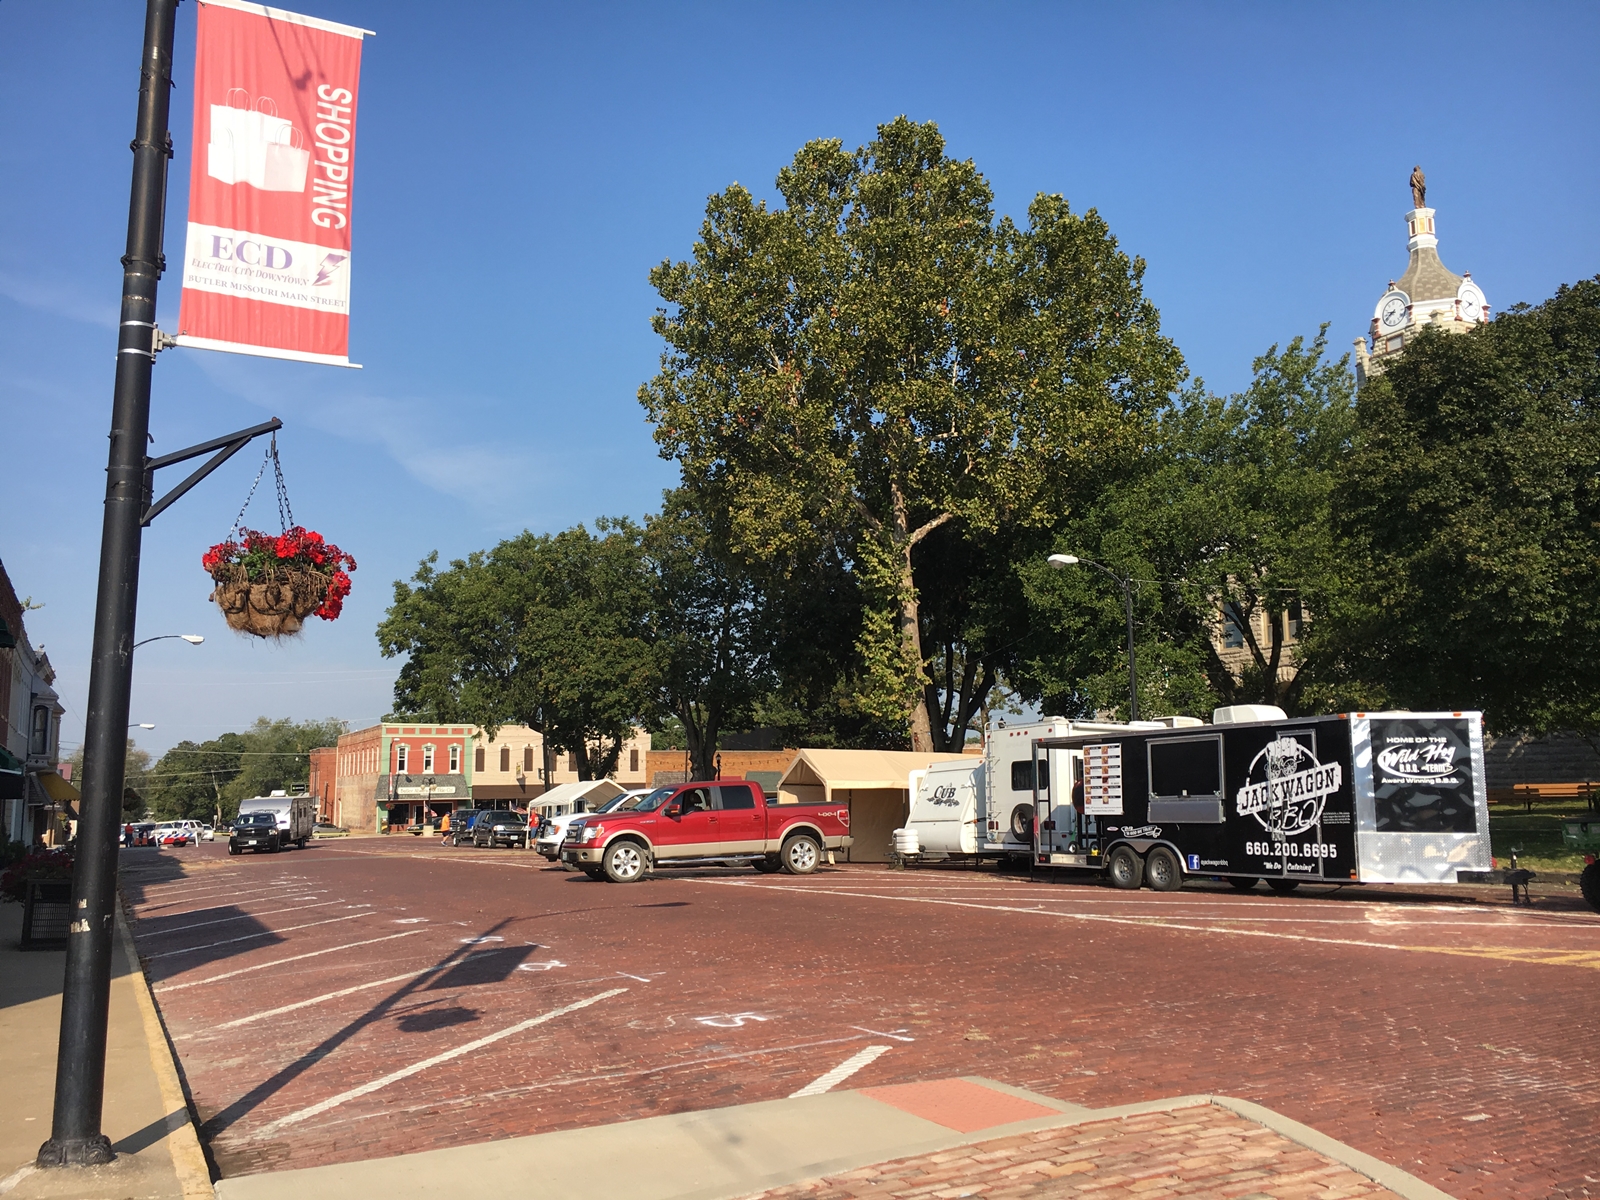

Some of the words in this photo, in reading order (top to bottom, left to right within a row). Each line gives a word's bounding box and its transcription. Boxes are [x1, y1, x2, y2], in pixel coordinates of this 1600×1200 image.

[311, 84, 352, 229] SHOPPING
[209, 235, 293, 270] ECD
[191, 258, 233, 273] ELECTRIC
[234, 265, 254, 277] CITY
[255, 269, 309, 286] DOWNTOWN
[188, 275, 228, 288] BUTLER
[230, 281, 278, 297] MISSOURI
[280, 292, 308, 302] MAIN
[310, 296, 346, 307] STREET
[1382, 748, 1420, 767] Wild
[1420, 743, 1456, 763] Hog
[934, 785, 956, 799] CUB
[1240, 767, 1336, 811] JACKWAGON
[1245, 841, 1338, 858] 660.200.6695
